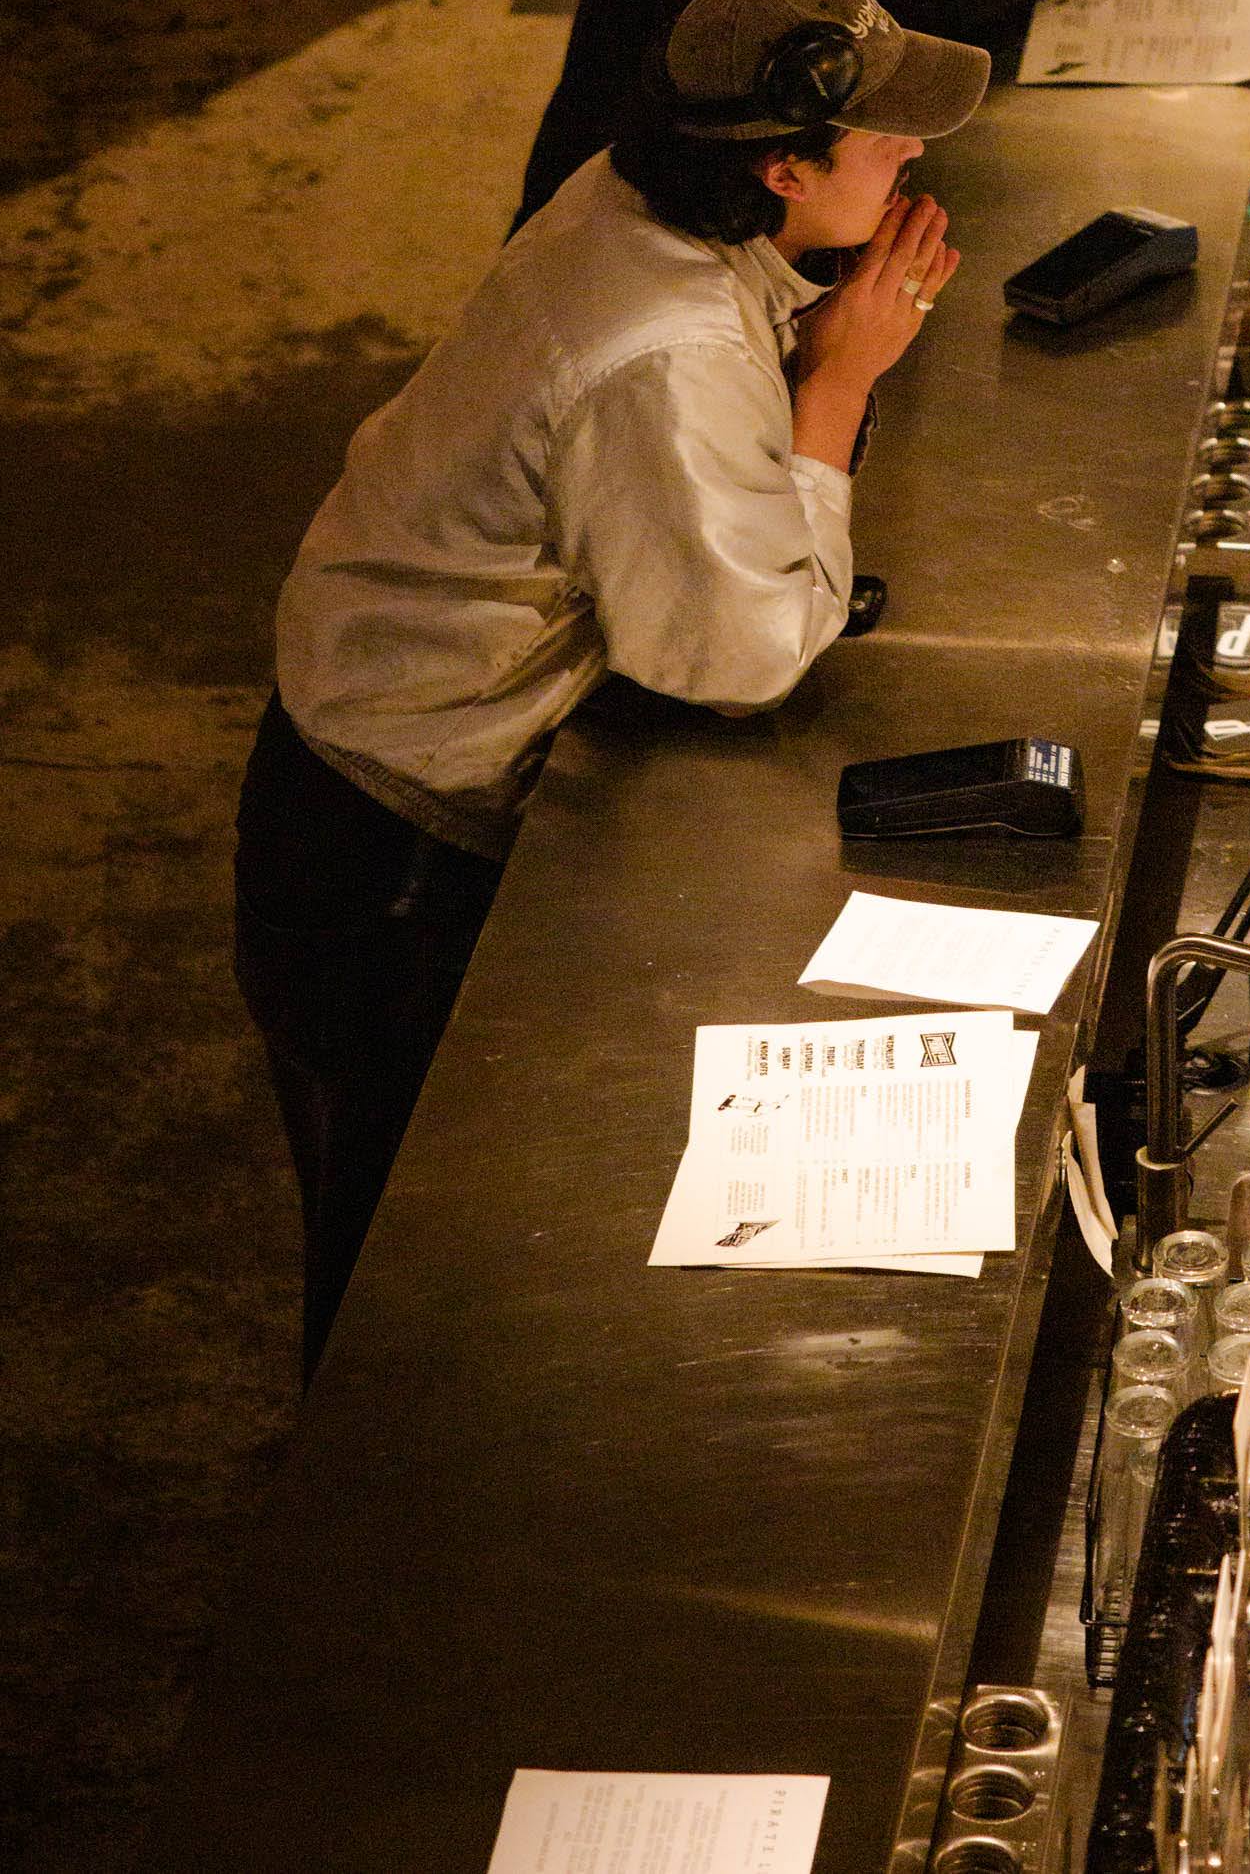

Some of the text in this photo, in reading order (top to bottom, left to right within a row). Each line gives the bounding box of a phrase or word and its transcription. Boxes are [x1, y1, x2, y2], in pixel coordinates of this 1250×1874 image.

[760, 1041, 768, 1076] KNOCK OFFS
[782, 1047, 791, 1069] SUNDAY
[805, 1042, 813, 1071] SATURDAY
[827, 1046, 836, 1066] FRIDAY
[856, 1039, 865, 1069] THURSDAY
